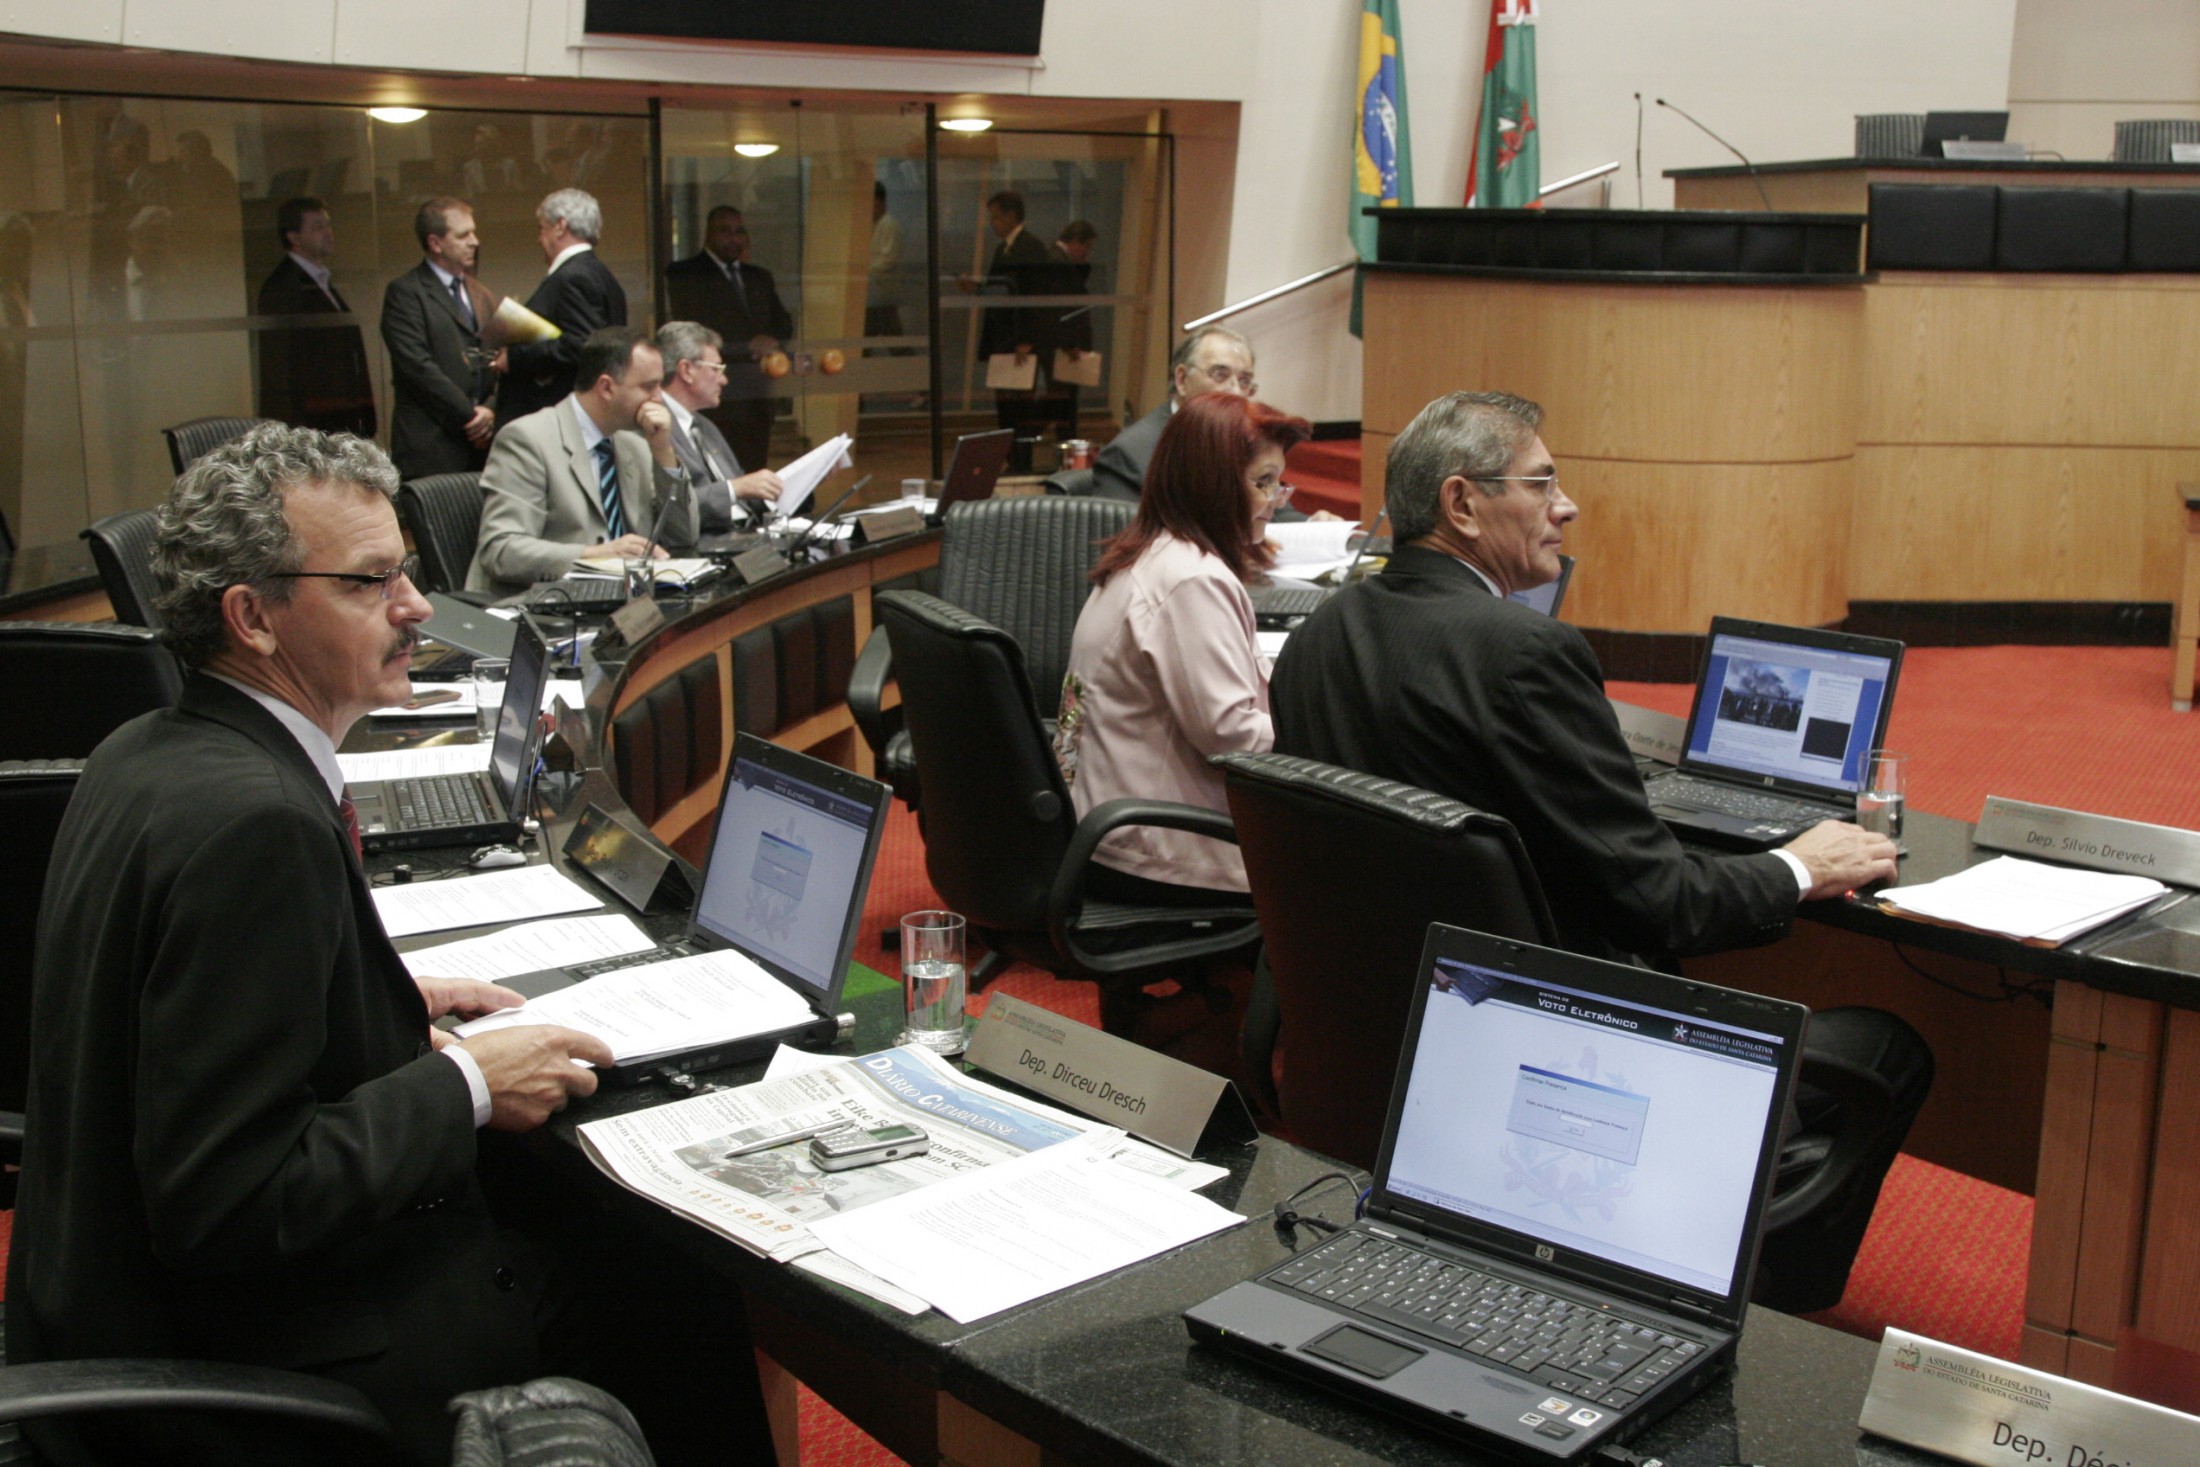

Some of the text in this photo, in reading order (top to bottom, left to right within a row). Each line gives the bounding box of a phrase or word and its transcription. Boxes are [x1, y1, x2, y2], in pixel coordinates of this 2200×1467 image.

[2026, 830, 2158, 867] Dep. Silvio Dreveck
[1538, 998, 1638, 1029] VOTO ELETRÔNICO
[1731, 1038, 1774, 1056] LEGISLATIVA
[1018, 1048, 1147, 1115] Dep. Dirceu Dresch
[840, 1098, 874, 1121] Eike
[1923, 1367, 2050, 1412] DO ESTADO DE SANTA CATARINA
[1926, 1355, 2052, 1400] ASSEMBLÉIA LEGISLATIVA
[1993, 1421, 2053, 1463] Dep.
